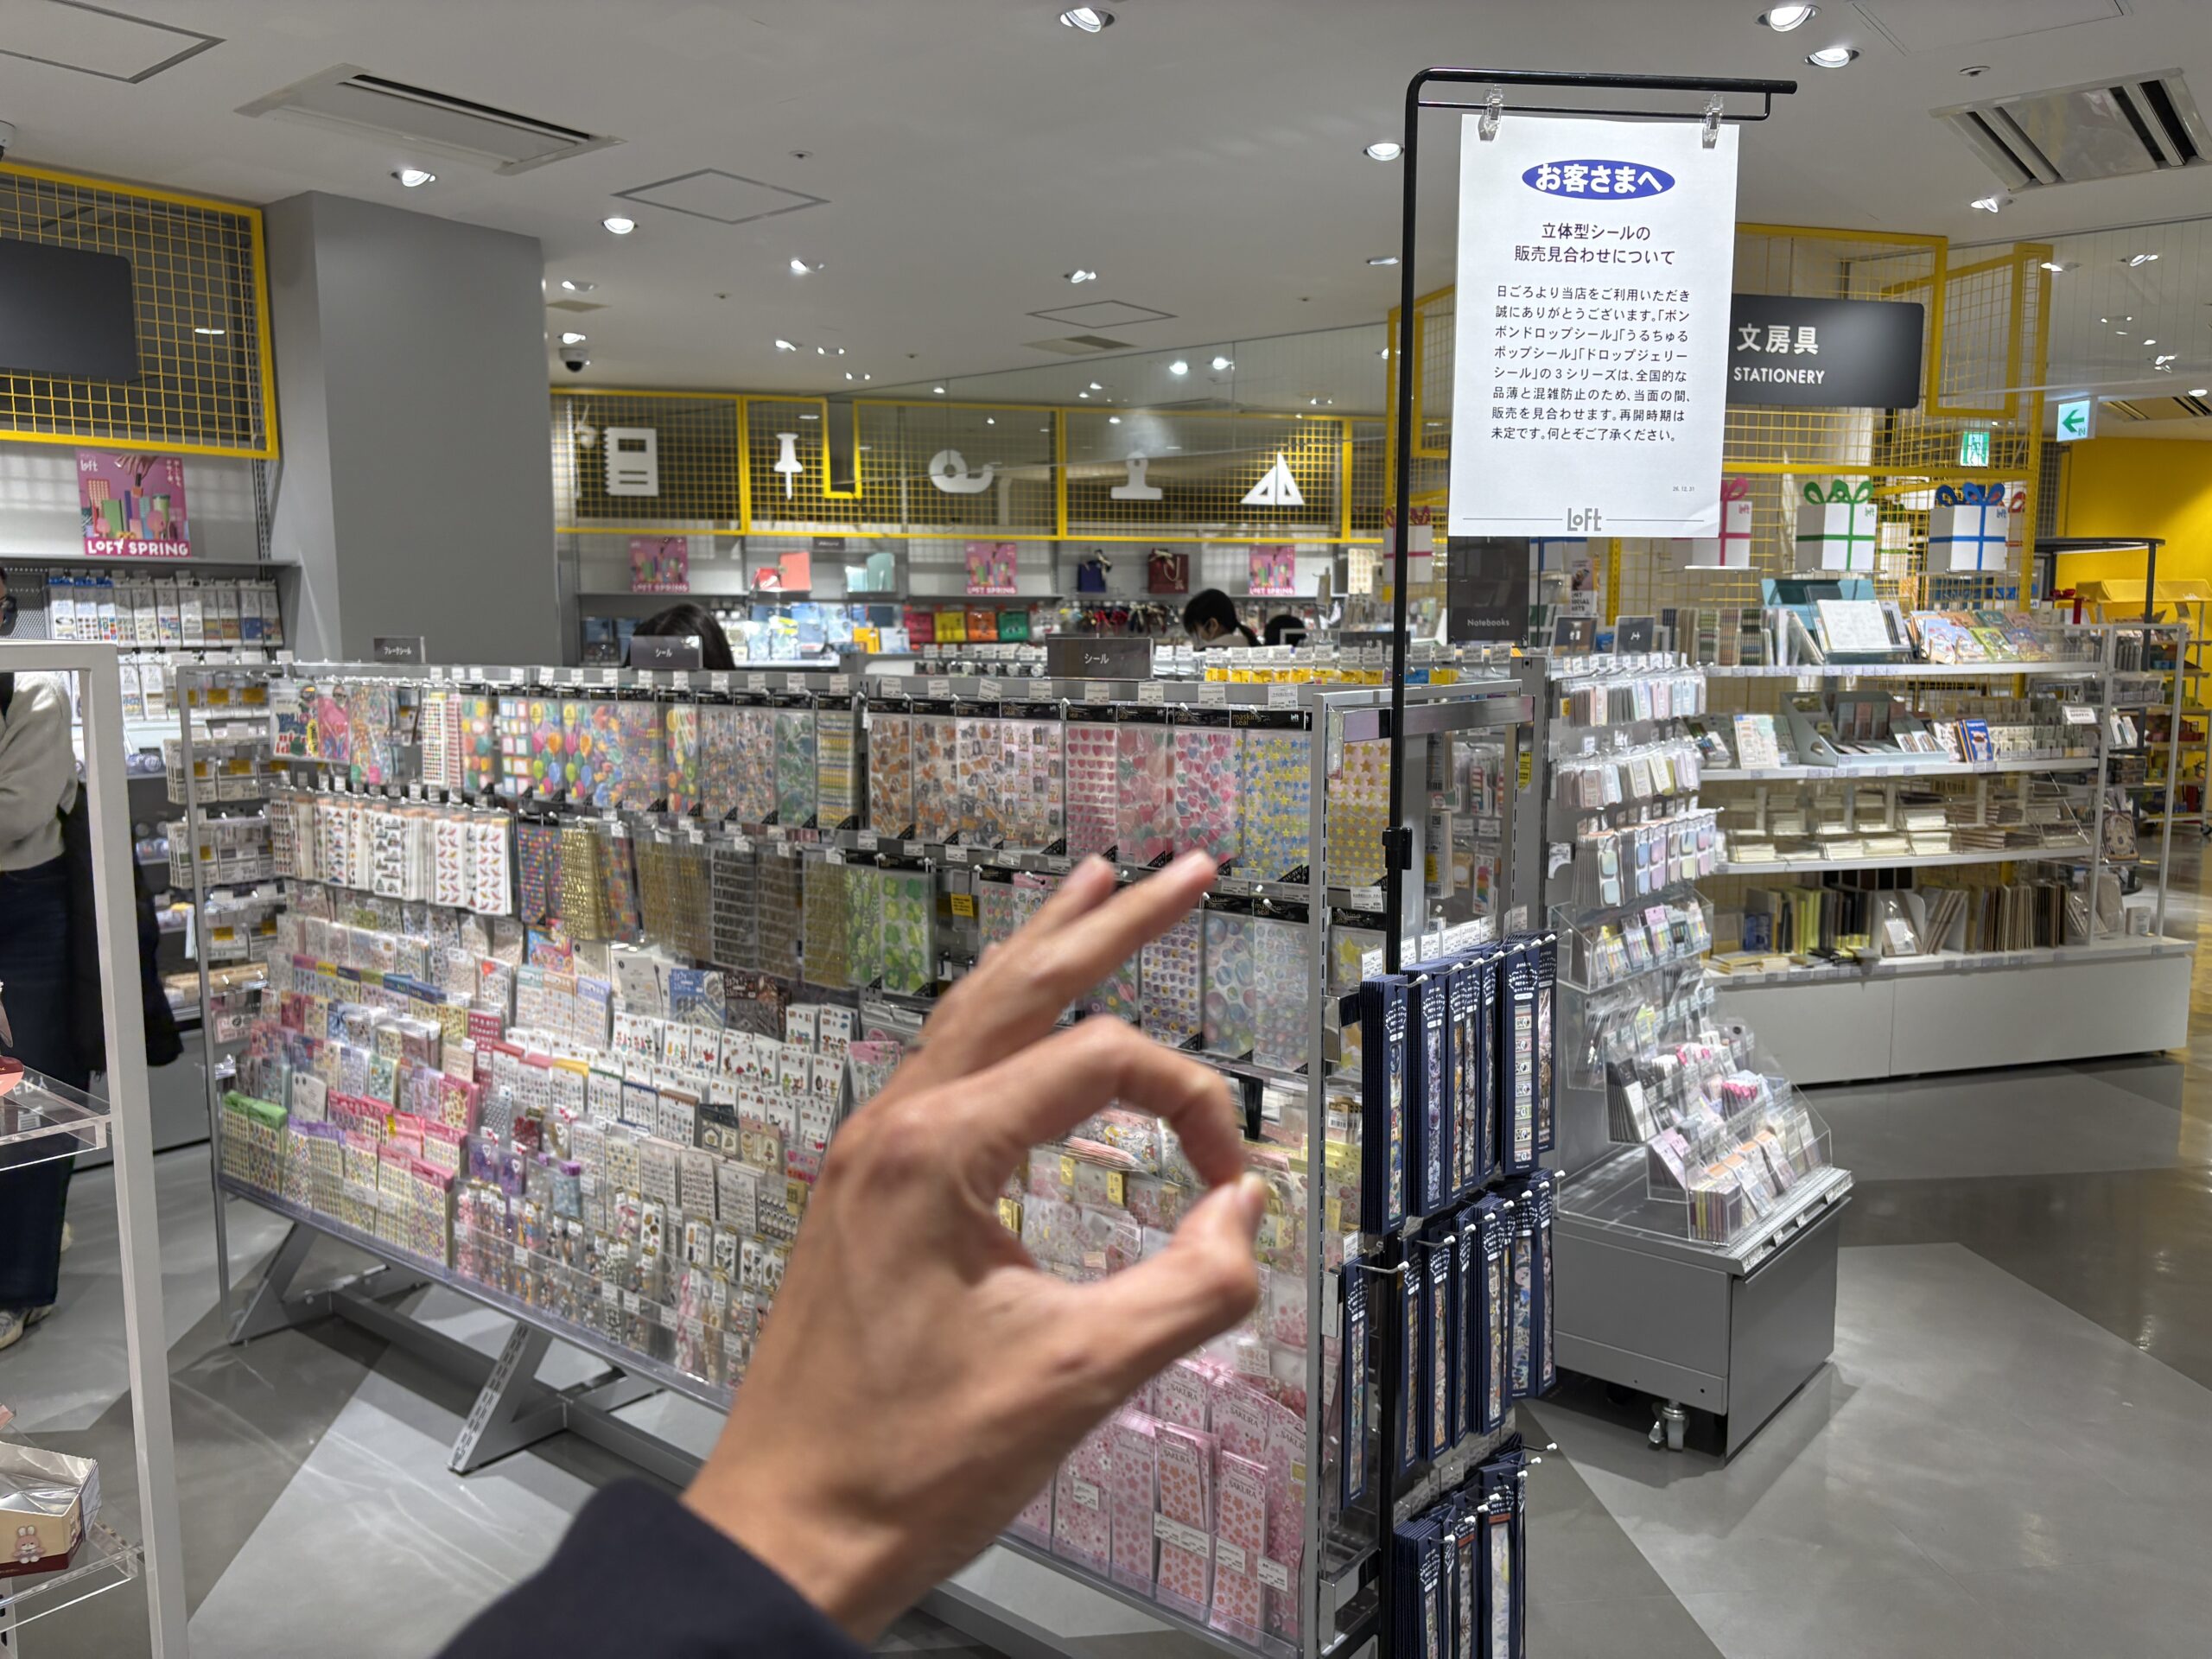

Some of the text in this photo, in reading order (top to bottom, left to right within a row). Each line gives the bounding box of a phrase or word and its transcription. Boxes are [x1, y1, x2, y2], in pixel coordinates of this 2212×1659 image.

[1535, 163, 1663, 194] お客さまへ
[1541, 222, 1651, 241] 立体型シールの
[1514, 245, 1675, 265] 販売見合わせについて
[1497, 285, 1691, 302] 日ごろより当店をご利用いただき
[1495, 305, 1690, 323] 誠にありがとうございます。「ボン
[1494, 325, 1689, 343] ボンドロップシール」「うるちゅる
[1736, 322, 1819, 355] 文房具
[1494, 346, 1688, 362] ポップシール」「ドロップジェリー
[1733, 366, 1826, 385] STATIONERY
[1492, 386, 1691, 403] 品薄と混雑防止のため、当面の間、
[1491, 406, 1685, 423] 販売を見合わせます。再開時期は
[1491, 427, 1675, 442] 未定です。何とぞご了承ください。
[128, 540, 188, 556] SPRING
[1466, 618, 1510, 626] Notebooks
[655, 647, 673, 658] シール
[1084, 652, 1109, 664] シール
[1232, 712, 1262, 723] masking
[1170, 1382, 1198, 1402] SAKURA
[1230, 1406, 1259, 1428] SAKURA
[1281, 1429, 1306, 1452] SAKUR
[1163, 1448, 1191, 1465] SAKURA
[1228, 1478, 1258, 1500] SAKURA
